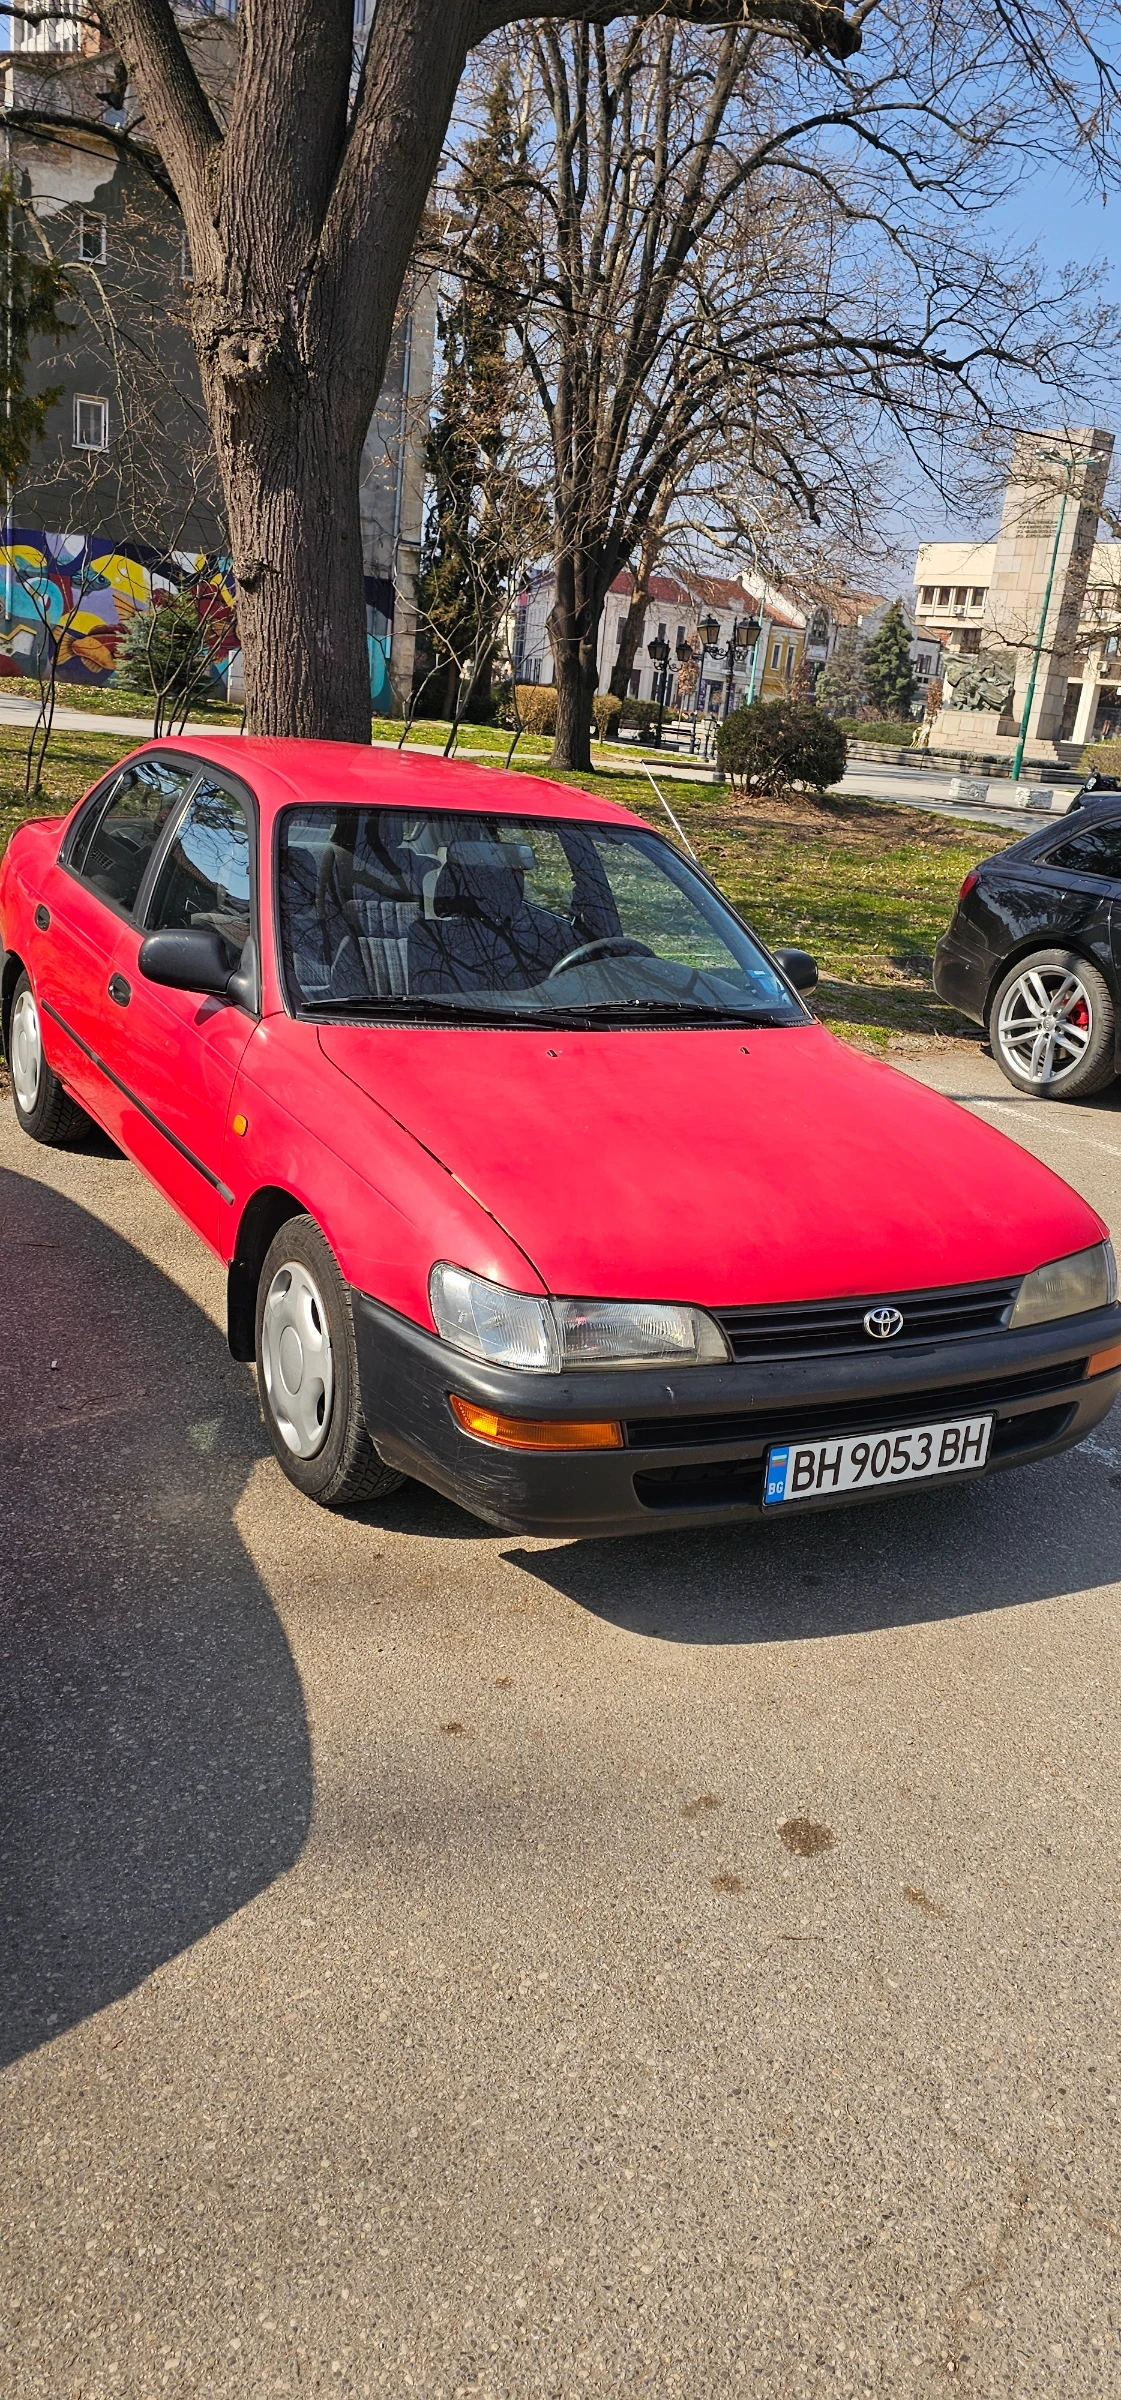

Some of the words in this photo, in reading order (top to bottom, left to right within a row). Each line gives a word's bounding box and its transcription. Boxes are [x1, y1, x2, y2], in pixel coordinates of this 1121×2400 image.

[791, 1446, 843, 1492] BH
[850, 1432, 933, 1483] 9053
[938, 1423, 985, 1468] BH
[768, 1481, 784, 1495] BG
